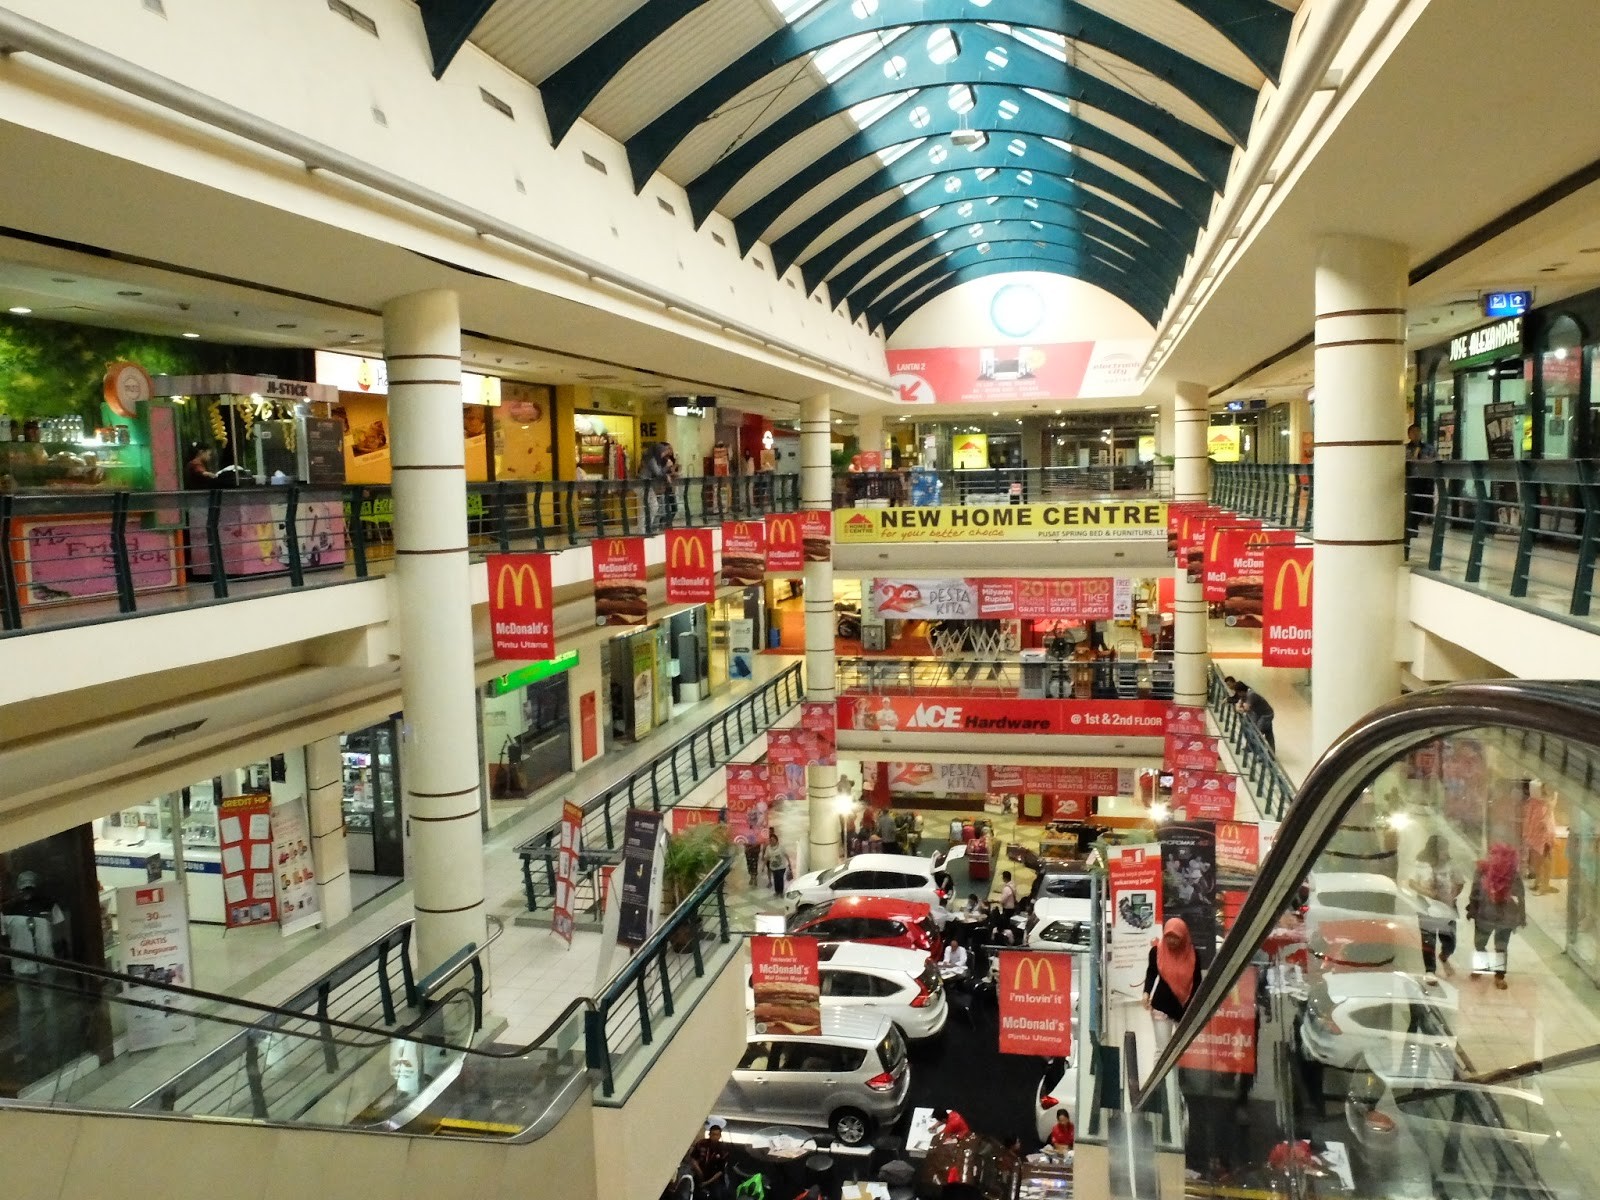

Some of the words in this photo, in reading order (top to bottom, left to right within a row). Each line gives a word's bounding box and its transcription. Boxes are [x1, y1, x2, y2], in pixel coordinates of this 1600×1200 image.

[881, 510, 941, 528] NEW
[951, 508, 1032, 527] HOME
[1043, 505, 1160, 526] CENTRE
[880, 529, 896, 538] for
[901, 531, 925, 540] your
[929, 529, 965, 538] better
[968, 528, 1004, 537] choice
[599, 563, 638, 573] McDonald's
[1233, 558, 1264, 568] McDon
[670, 577, 709, 586] McDonald's
[1081, 580, 1109, 594] 100
[1020, 580, 1045, 597] 20
[1052, 580, 1074, 597] 10
[1082, 594, 1109, 602] TIKET
[495, 622, 549, 635] McDonald's
[1269, 625, 1312, 640] McDon
[520, 641, 548, 649] Utama
[1269, 647, 1299, 655] Pintu
[906, 702, 963, 728] ACE
[965, 715, 1050, 729] Hardware
[1083, 713, 1100, 725] 1st
[1101, 713, 1111, 725] &
[1112, 713, 1133, 725] 2nd
[1134, 717, 1162, 726] FLOOR
[759, 963, 809, 975] McDonald's
[1002, 1016, 1065, 1032] McDonald's
[1032, 1034, 1062, 1043] Utama
